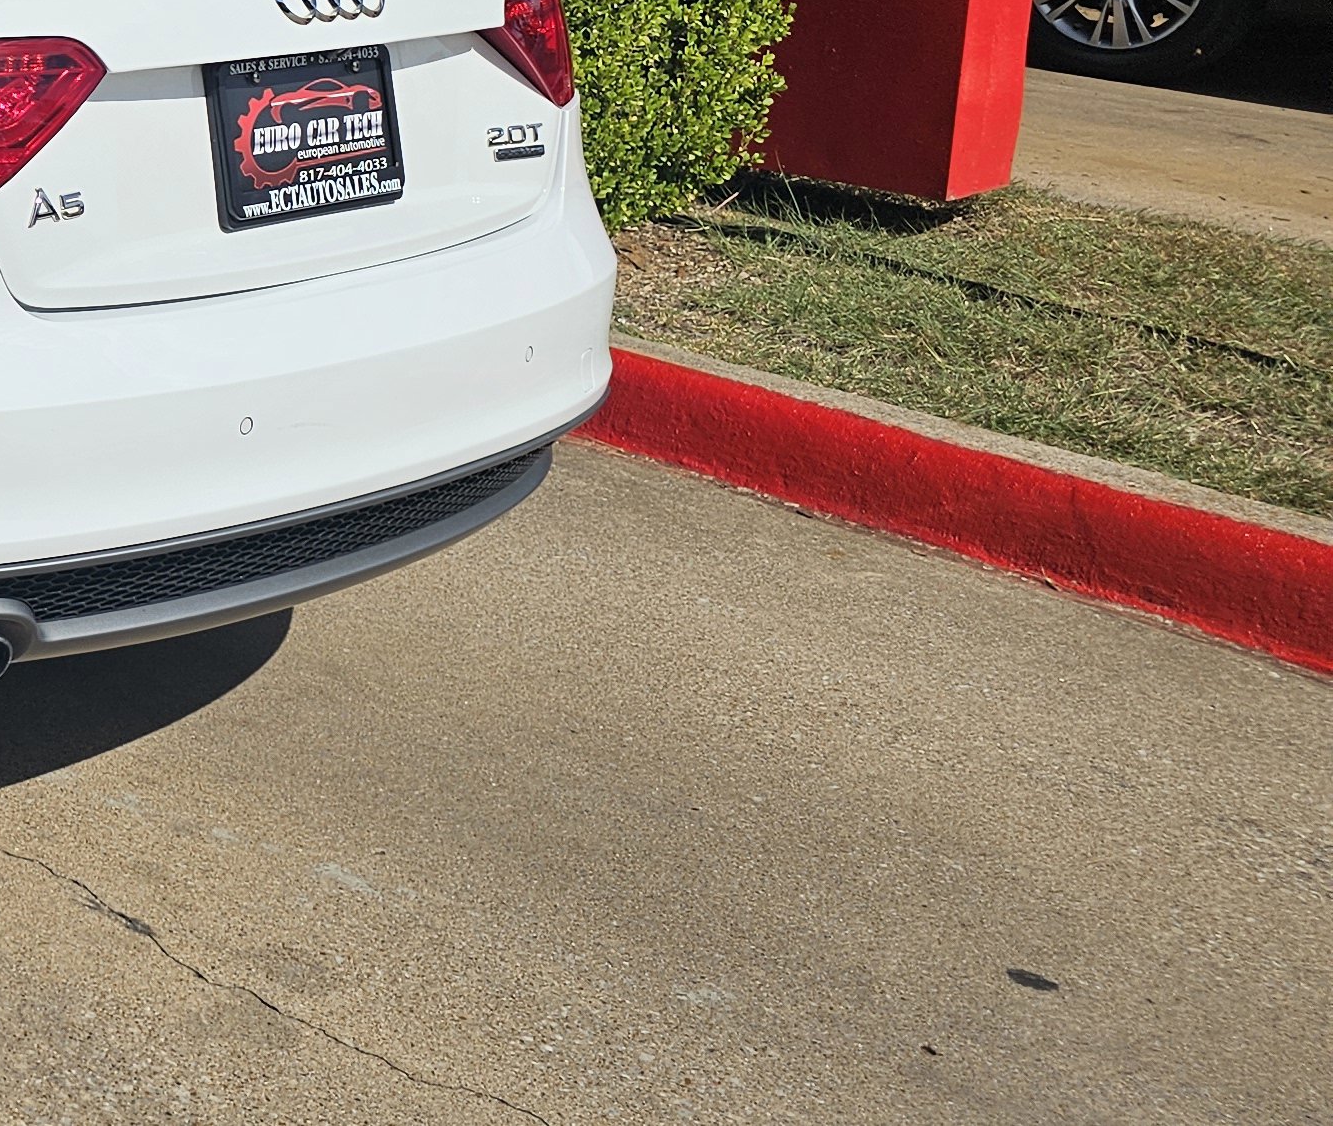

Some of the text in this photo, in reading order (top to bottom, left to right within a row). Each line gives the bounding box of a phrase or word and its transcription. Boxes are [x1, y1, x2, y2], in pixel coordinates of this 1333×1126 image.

[229, 62, 257, 75] SALES
[258, 61, 267, 72] &
[268, 55, 308, 70] SERVICE
[253, 111, 383, 155] EURO CAR TECH
[297, 137, 385, 160] european automotive
[299, 157, 388, 183] 817-404-4033
[28, 188, 85, 228] A5
[243, 172, 401, 218] www.ECTAUTOSALES.com
